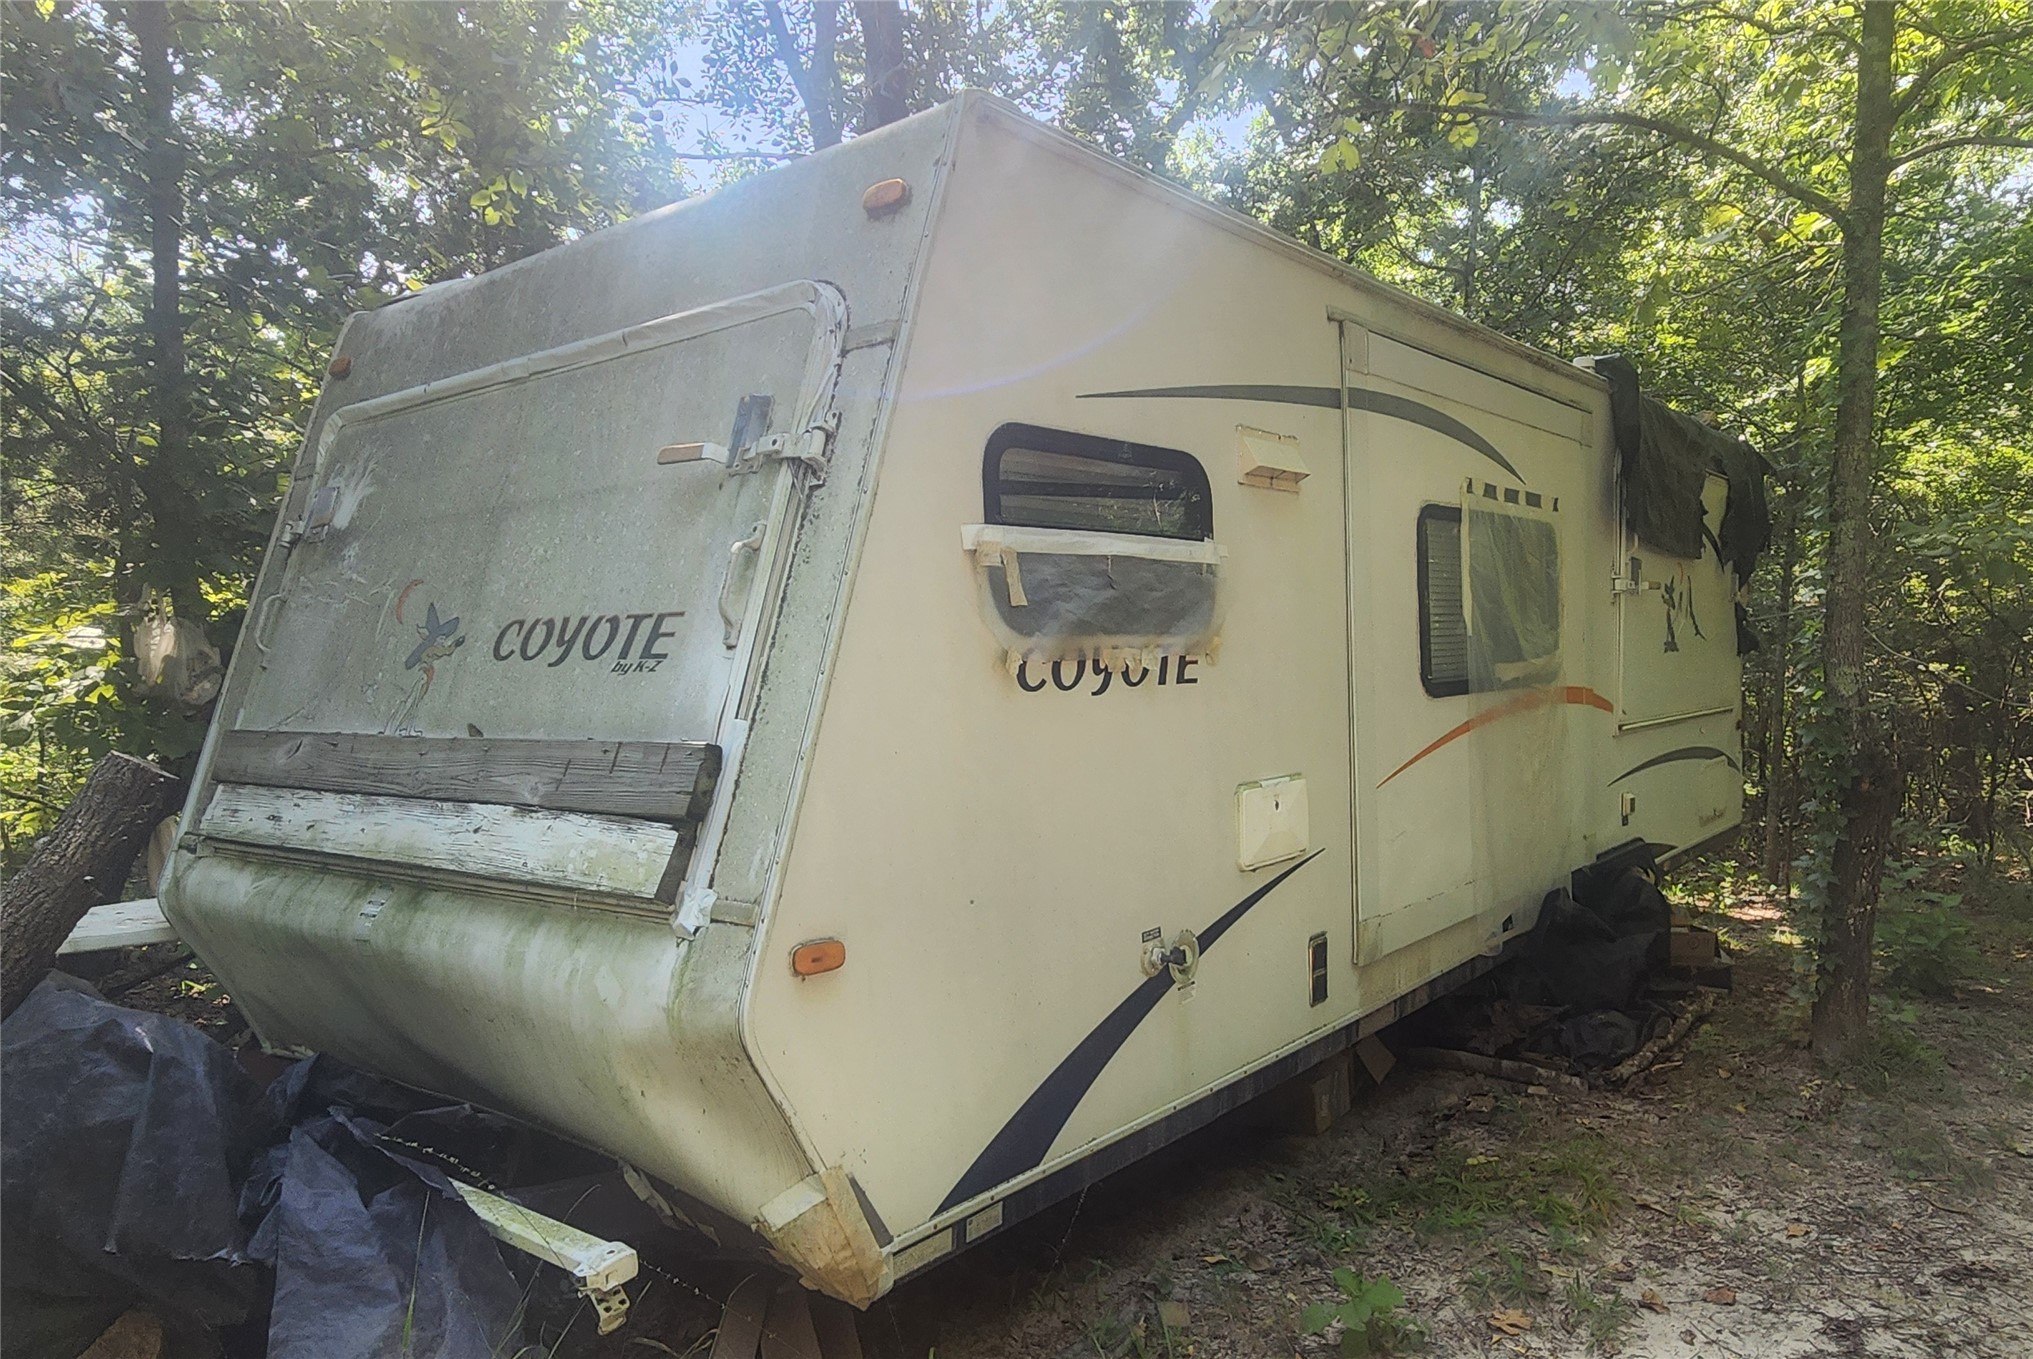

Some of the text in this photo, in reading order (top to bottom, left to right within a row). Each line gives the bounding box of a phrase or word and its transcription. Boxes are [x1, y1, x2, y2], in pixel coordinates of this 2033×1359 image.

[492, 611, 686, 667] COYOTE
[611, 660, 664, 676] by K-Z
